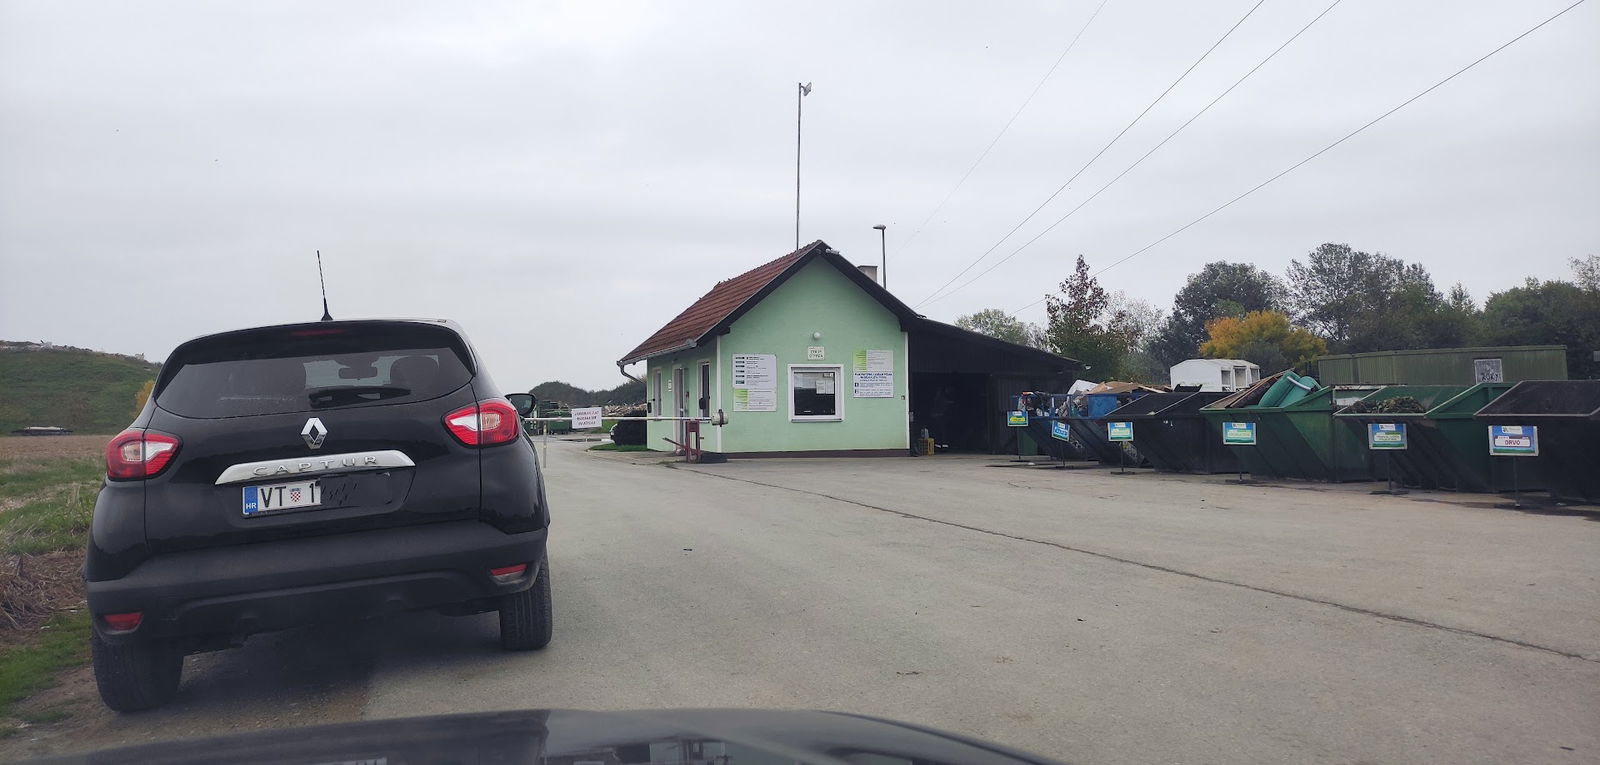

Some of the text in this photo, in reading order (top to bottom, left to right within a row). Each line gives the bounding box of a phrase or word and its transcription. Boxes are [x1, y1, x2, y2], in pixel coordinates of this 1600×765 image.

[253, 455, 378, 477] CAPTUR
[245, 502, 257, 510] HR
[260, 485, 287, 508] VT
